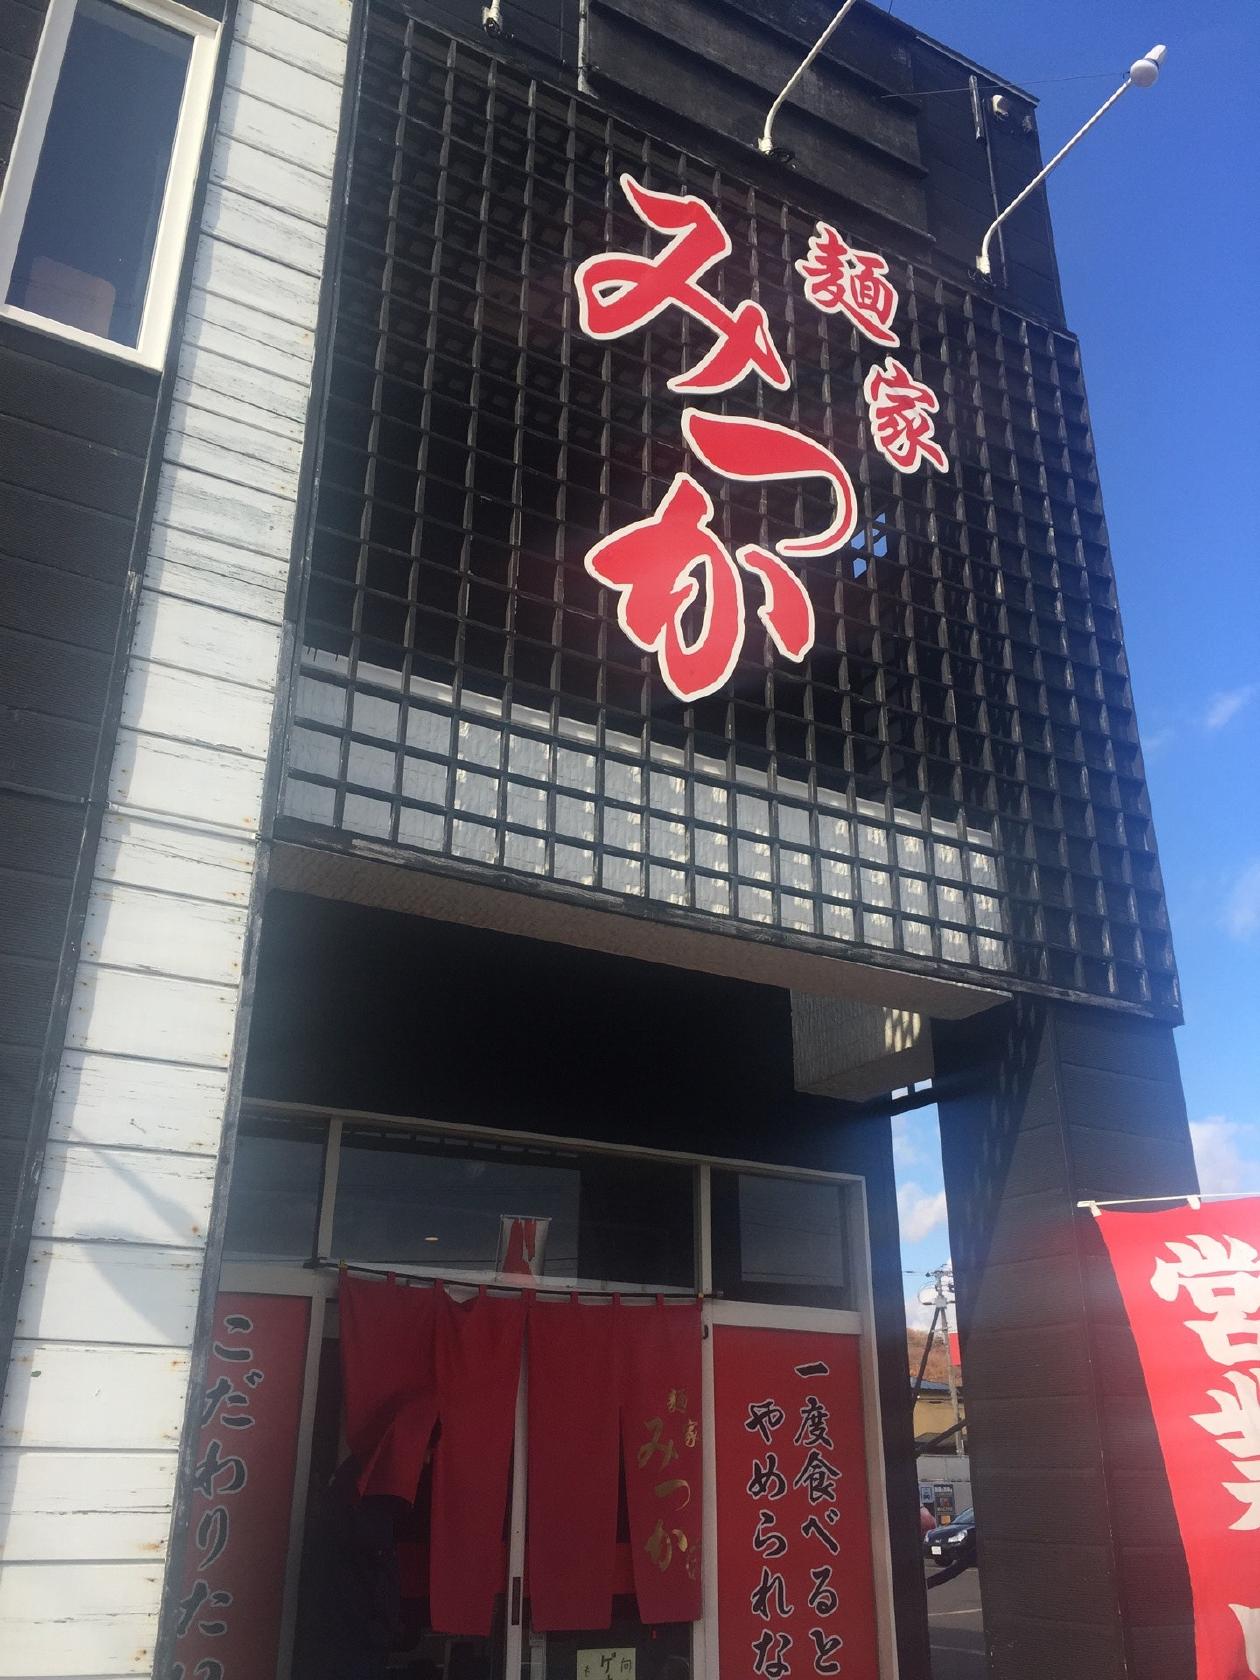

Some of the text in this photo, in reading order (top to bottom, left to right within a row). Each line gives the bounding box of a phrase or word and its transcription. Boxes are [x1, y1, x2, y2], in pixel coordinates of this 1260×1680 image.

[575, 172, 858, 702] みつか
[796, 221, 949, 473] 麺家
[637, 1416, 692, 1573] みつか
[745, 1399, 794, 1680] やめられな
[793, 1360, 843, 1676] 一度食べると
